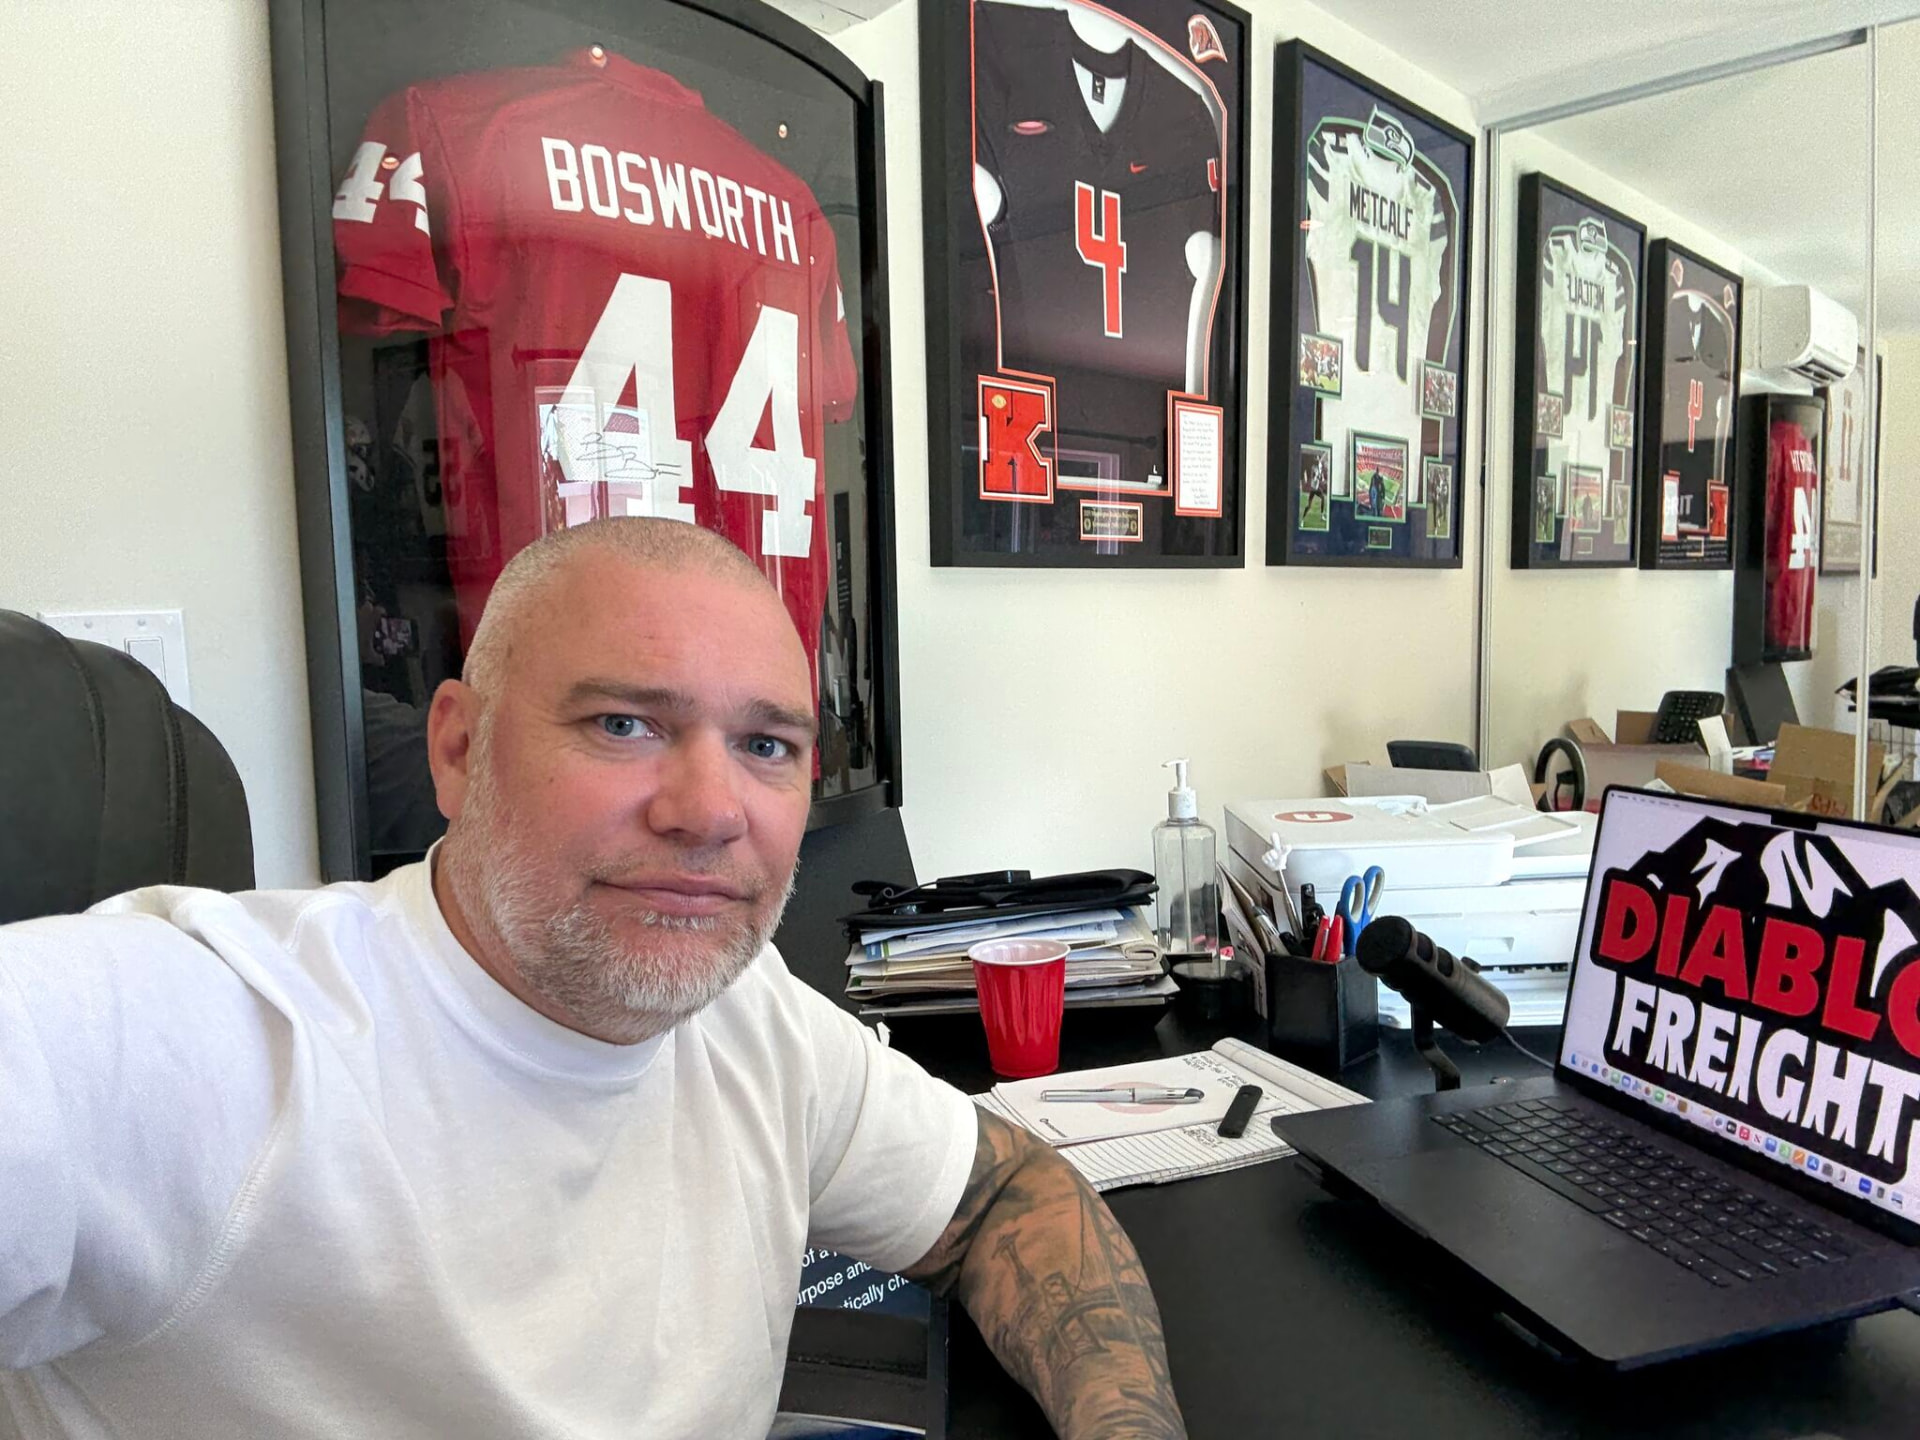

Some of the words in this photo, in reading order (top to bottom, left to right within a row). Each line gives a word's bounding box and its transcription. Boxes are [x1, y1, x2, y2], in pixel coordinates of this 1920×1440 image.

[541, 136, 800, 265] BOSWORTH
[1075, 180, 1127, 339] 4
[1349, 181, 1413, 240] METCALF
[1351, 235, 1411, 384] 14
[545, 272, 816, 557] 44
[1612, 978, 1920, 1164] FREIGHT
[796, 1272, 843, 1305] urpose
[801, 1247, 815, 1268] of
[839, 1284, 884, 1310] tically
